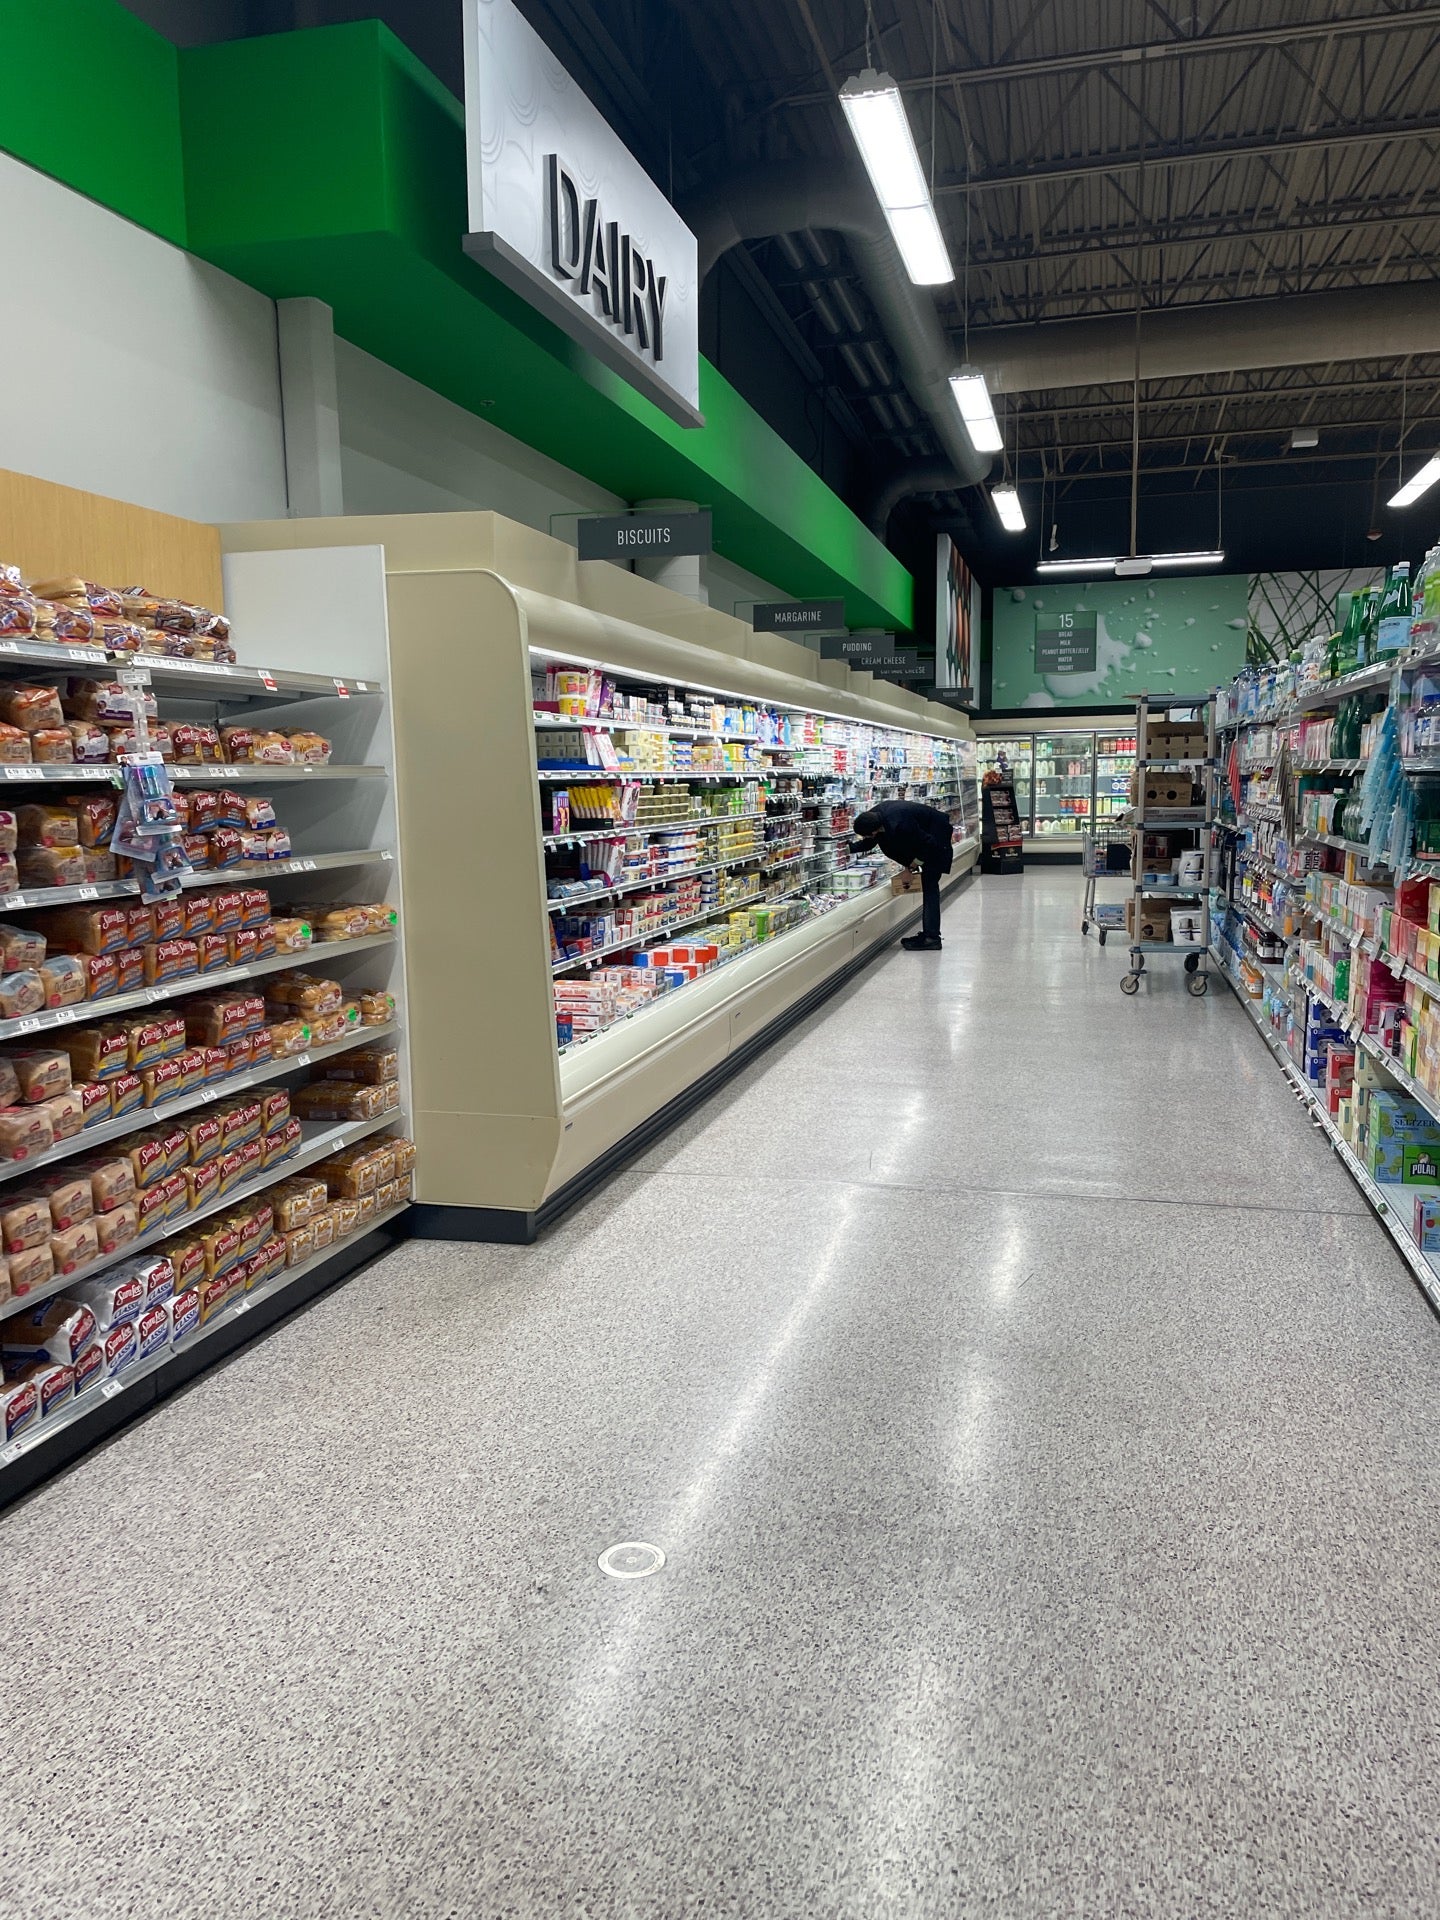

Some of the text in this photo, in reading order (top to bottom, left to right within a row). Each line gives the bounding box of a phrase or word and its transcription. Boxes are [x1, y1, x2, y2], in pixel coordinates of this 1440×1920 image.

[548, 153, 667, 361] DAIRY
[617, 528, 670, 545] BISCUITS
[774, 611, 822, 623] MARGARINE
[1059, 613, 1074, 628] 15
[842, 642, 872, 652] PUDDING
[861, 656, 906, 665] CREAM CHEESE
[1395, 1118, 1436, 1128] SELTZER
[1412, 1163, 1436, 1177] POLAR
